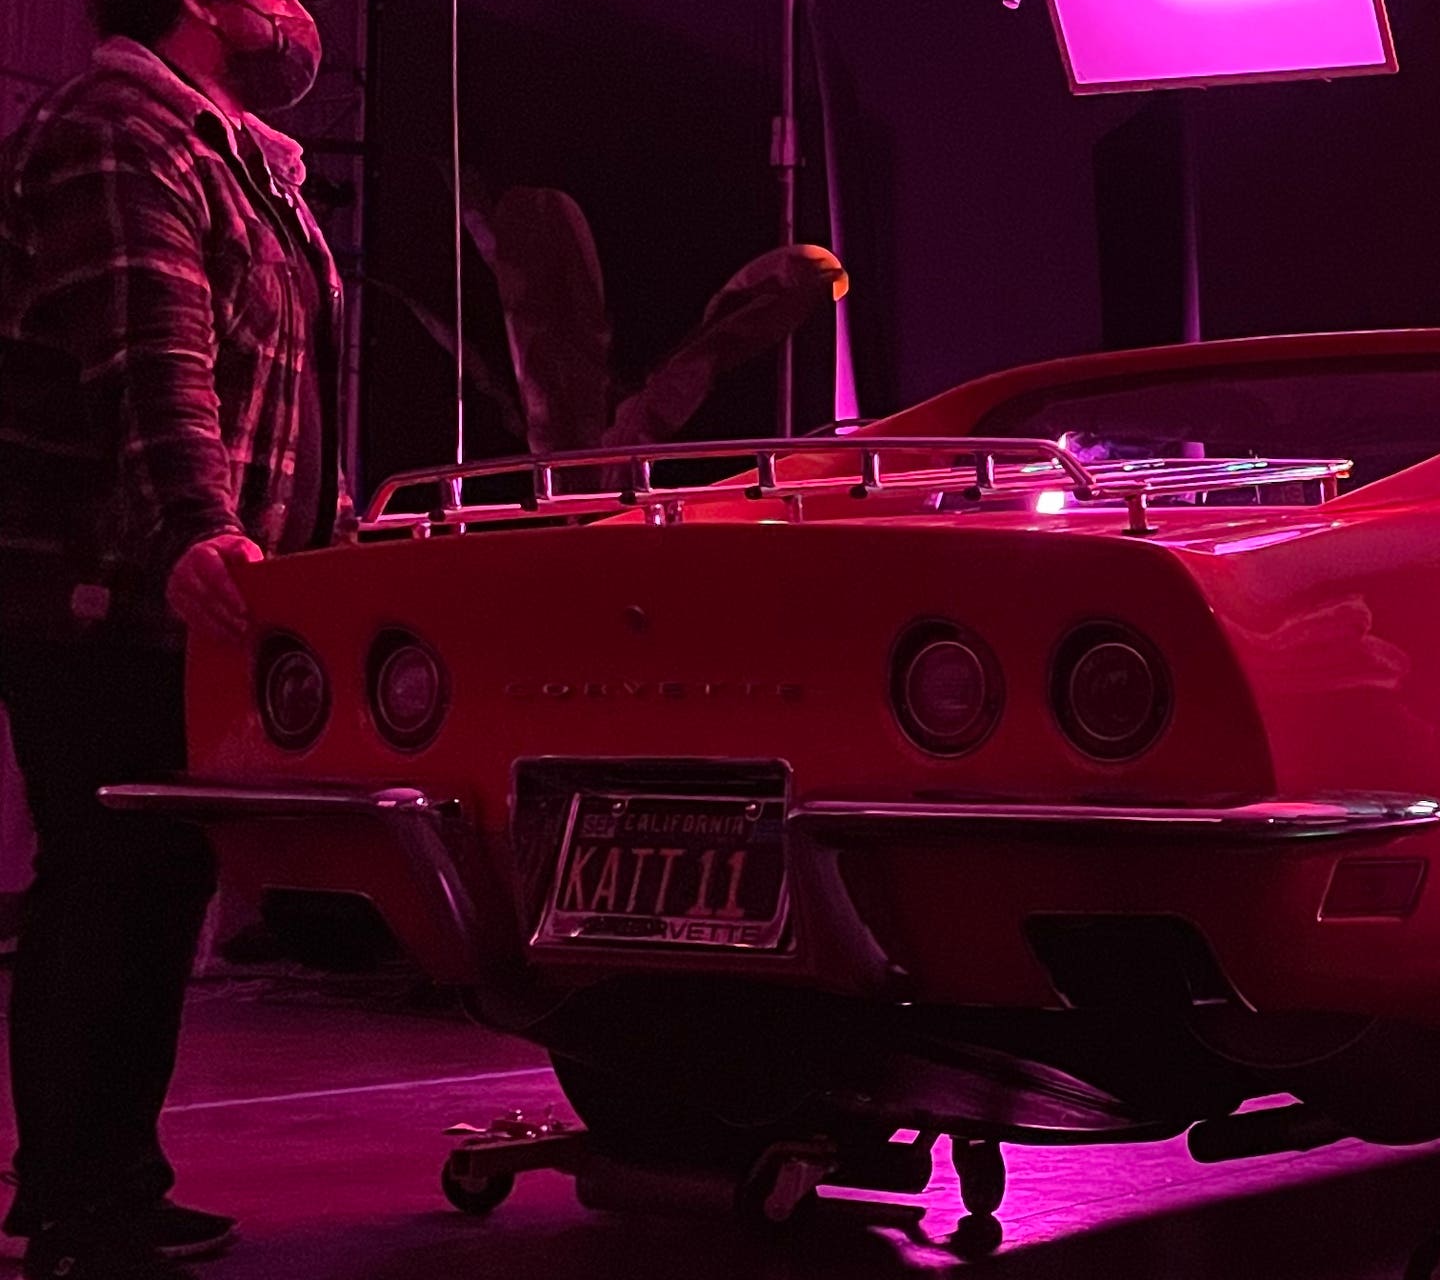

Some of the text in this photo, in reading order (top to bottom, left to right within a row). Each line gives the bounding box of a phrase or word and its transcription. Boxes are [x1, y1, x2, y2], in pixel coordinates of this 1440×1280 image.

[504, 679, 802, 697] CORVETTE
[624, 813, 744, 835] CALIFORNIA
[562, 845, 748, 917] KATT 11
